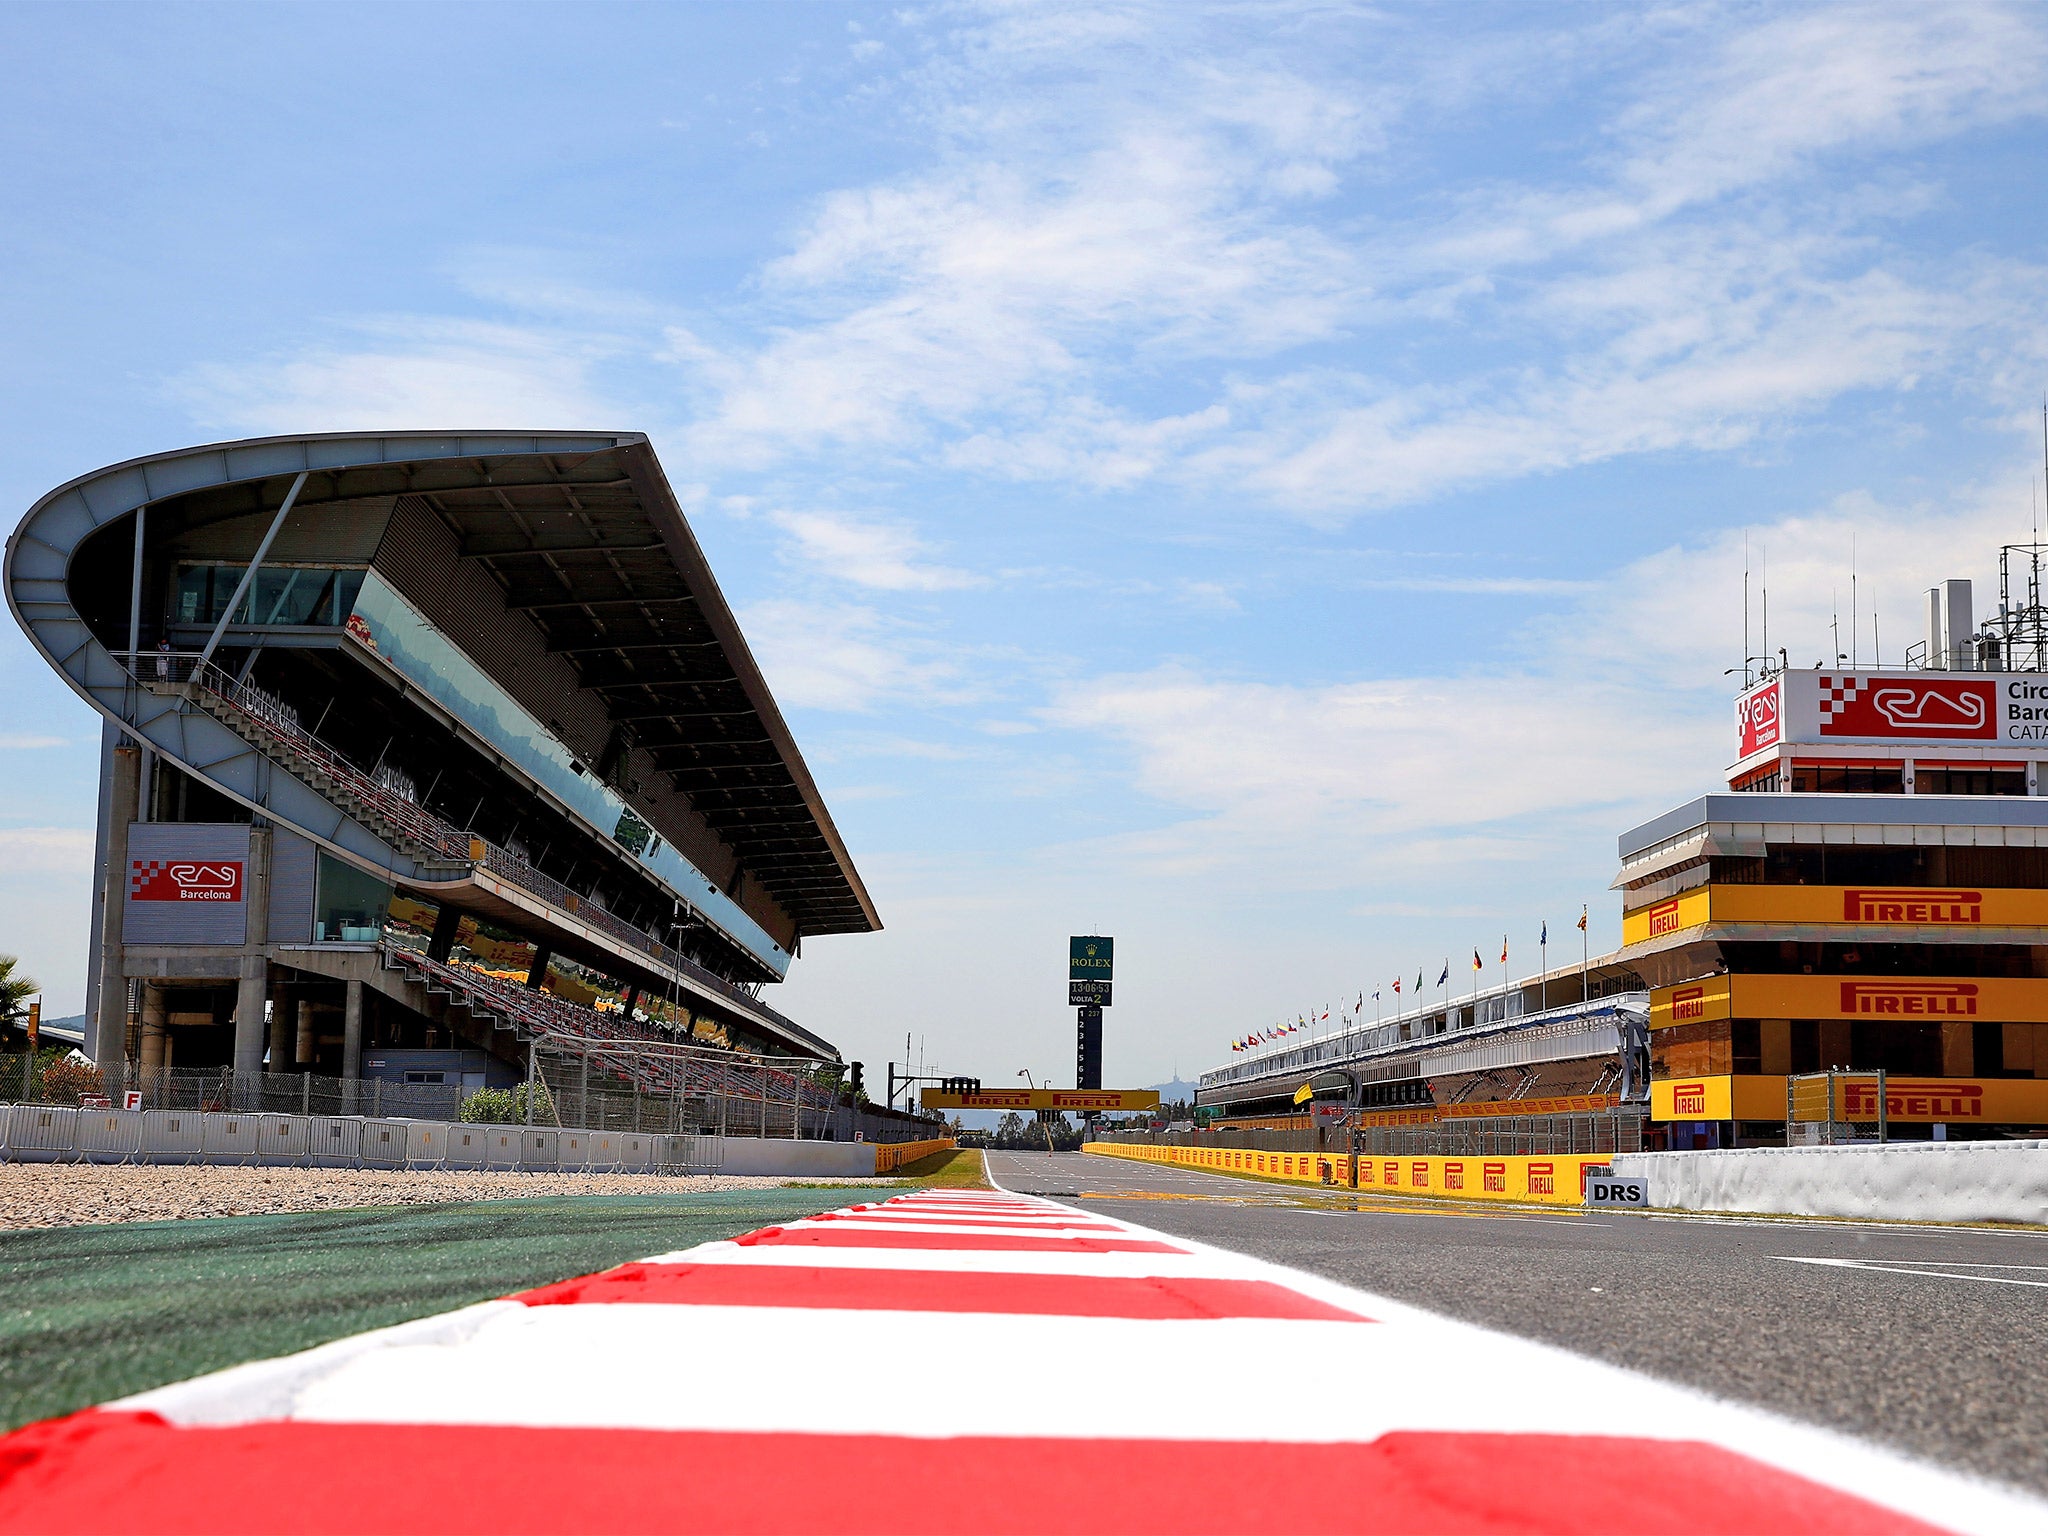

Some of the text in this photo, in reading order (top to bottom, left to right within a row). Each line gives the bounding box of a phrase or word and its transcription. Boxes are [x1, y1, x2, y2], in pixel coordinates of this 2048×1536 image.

[2008, 681, 2048, 699] Circ
[181, 890, 231, 899] Barcelona
[1844, 890, 1982, 923] PIRELLI
[1649, 899, 1679, 936] PIRELLI
[1071, 959, 1111, 968] ROLEX
[1094, 994, 1101, 1003] 2
[1672, 986, 1703, 1020] PIRELLI
[1841, 982, 1979, 1015] PIRELLI
[127, 1093, 140, 1109] F
[962, 1093, 1030, 1105] PIRELLI
[1053, 1094, 1121, 1106] PIRELLI
[1673, 1084, 1704, 1114] PIRELLI
[1845, 1083, 1983, 1117] PIRELLI
[1445, 1163, 1463, 1190] PIRELLI
[1484, 1163, 1505, 1192] PIRELLI
[1528, 1163, 1553, 1194] PIRELLI
[1594, 1184, 1640, 1201] DRS
